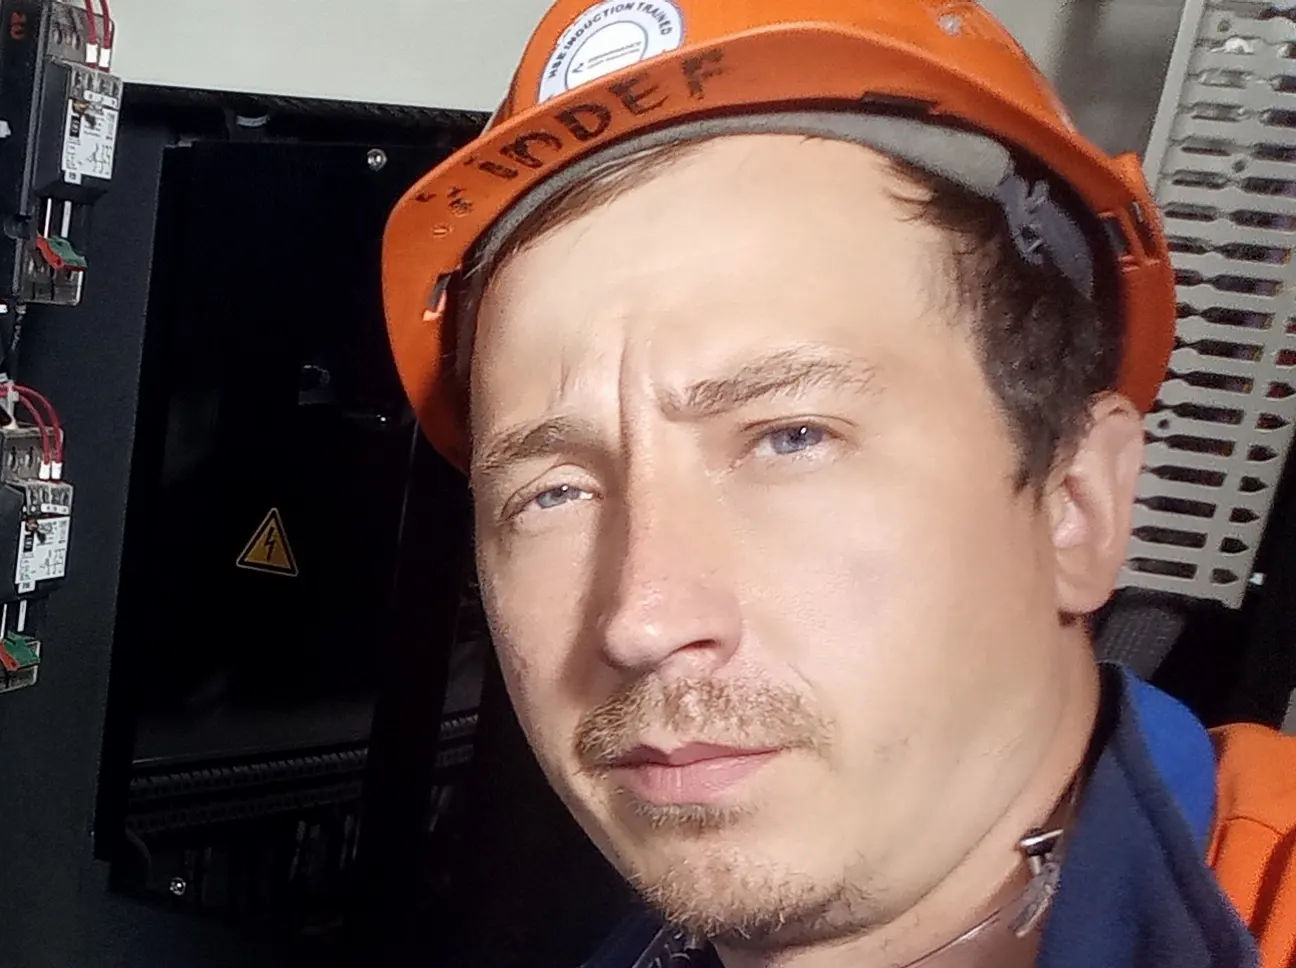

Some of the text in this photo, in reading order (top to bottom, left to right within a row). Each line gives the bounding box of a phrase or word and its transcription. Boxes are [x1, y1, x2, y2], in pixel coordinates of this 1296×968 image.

[547, 52, 567, 79] HSE
[564, 2, 634, 50] INDUCTION
[636, 2, 672, 36] TRAINED
